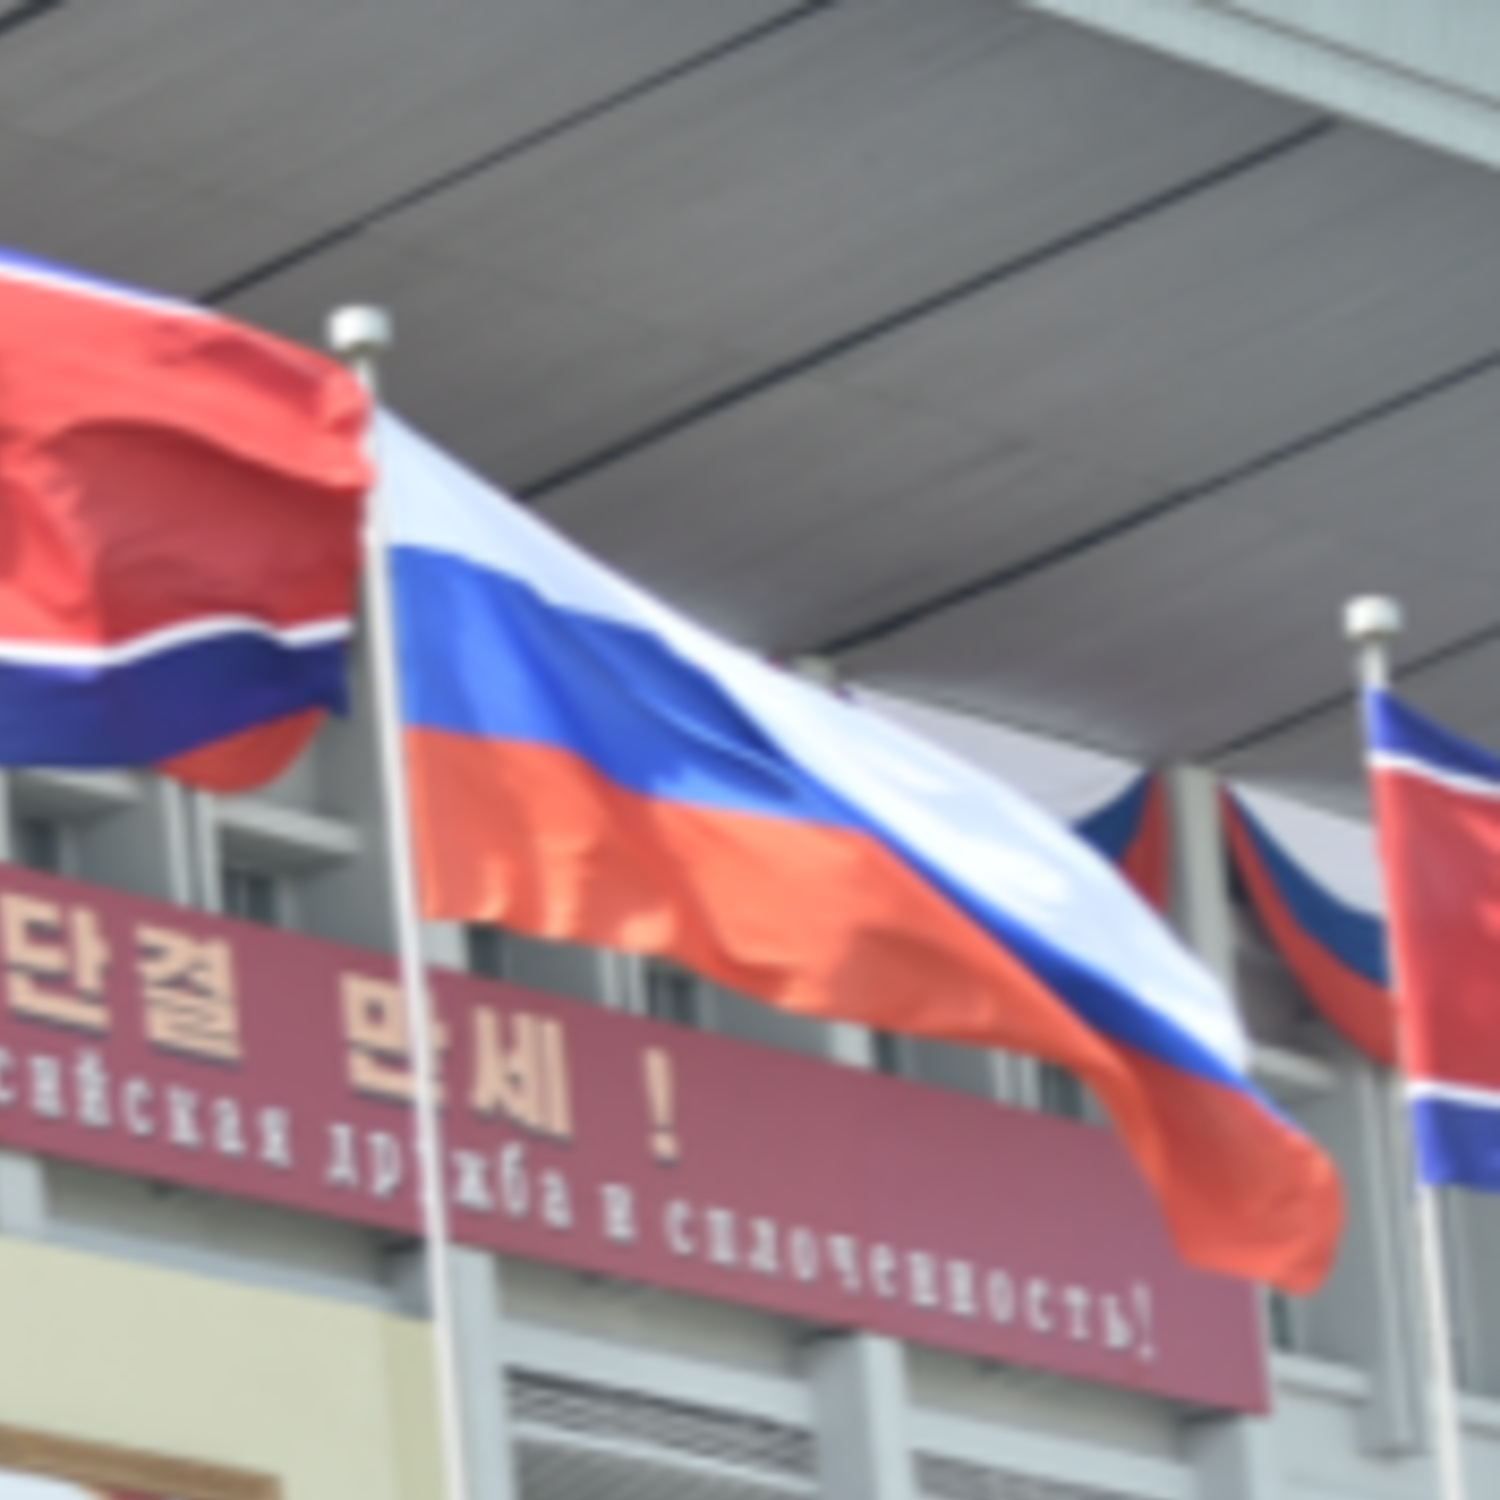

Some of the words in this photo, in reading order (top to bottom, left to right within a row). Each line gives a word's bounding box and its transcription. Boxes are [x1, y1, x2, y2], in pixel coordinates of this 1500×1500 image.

[340, 972, 572, 1138] 만세
[642, 1047, 680, 1160] !
[325, 1120, 572, 1230] држба
[601, 1183, 638, 1243] и
